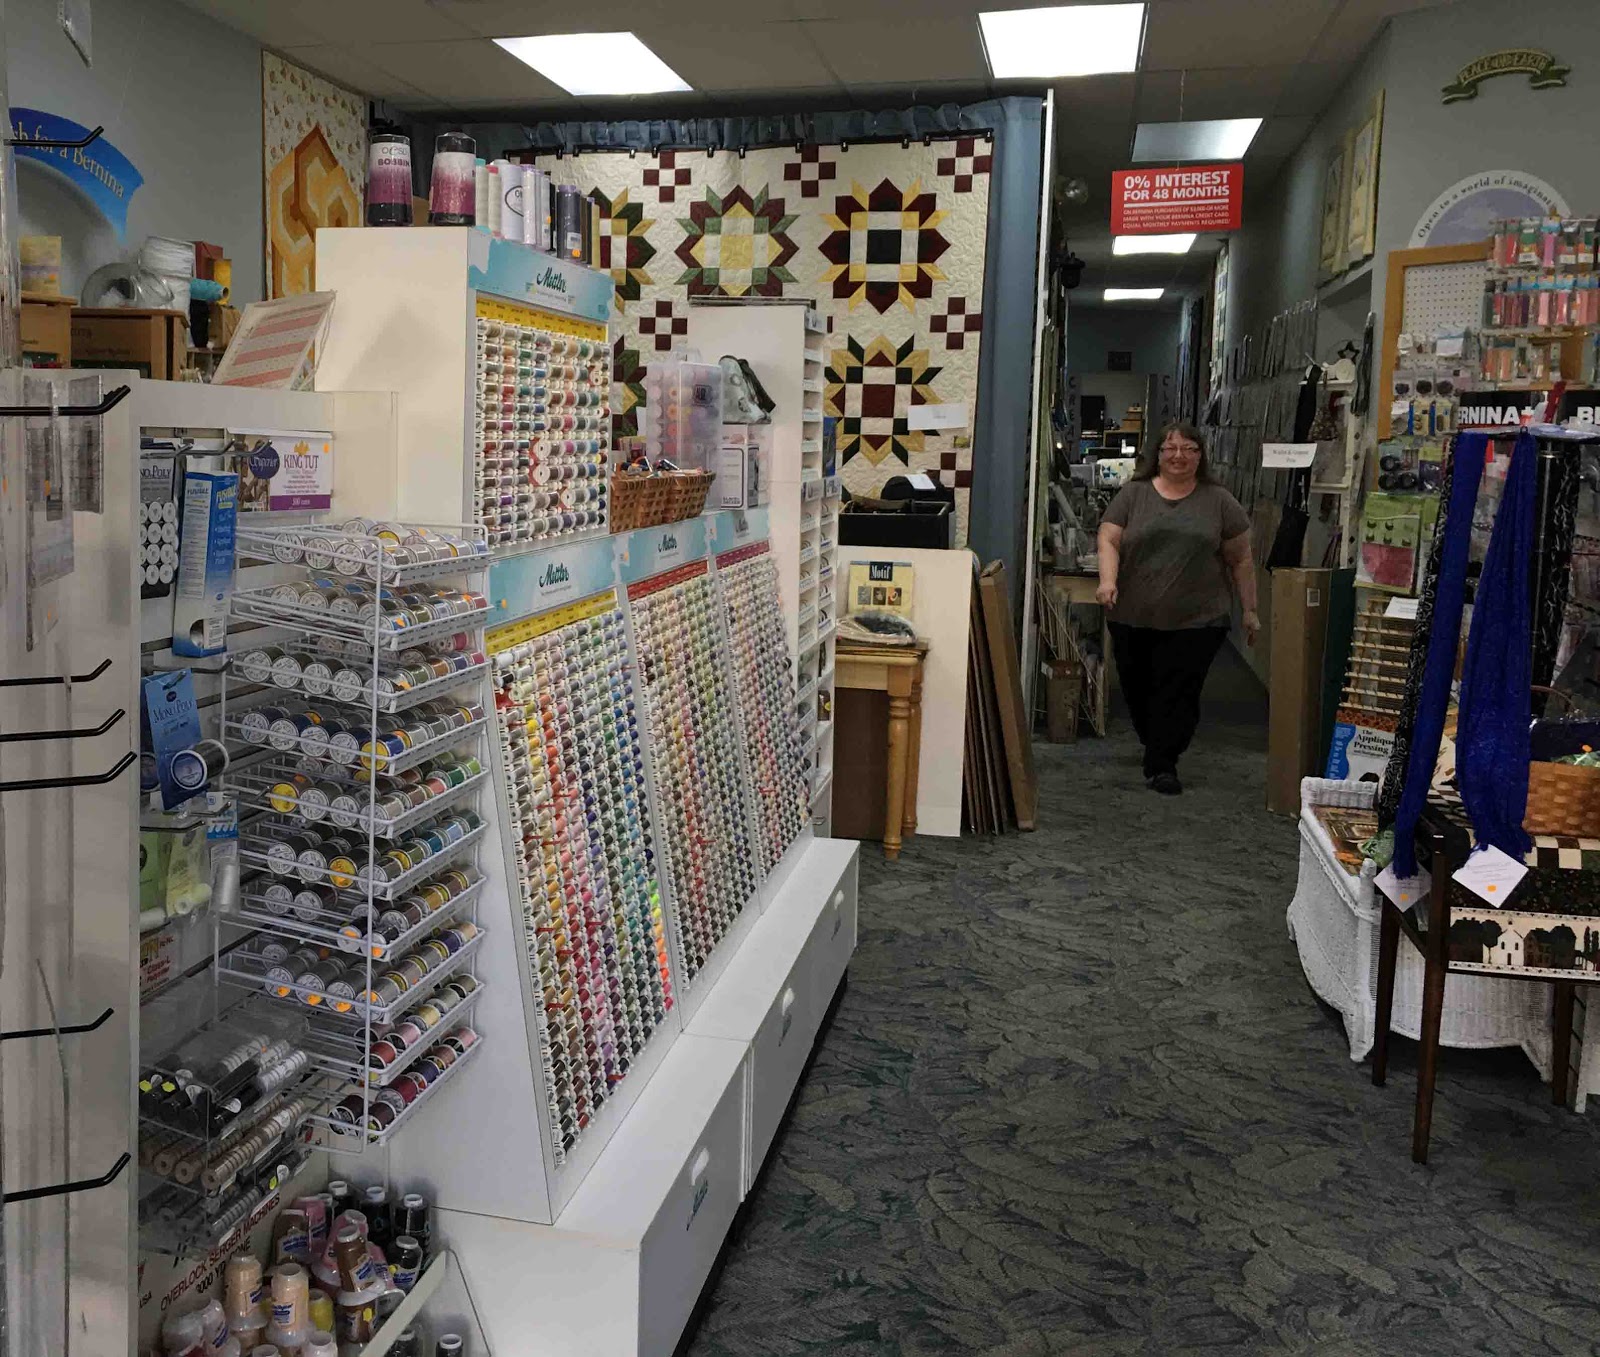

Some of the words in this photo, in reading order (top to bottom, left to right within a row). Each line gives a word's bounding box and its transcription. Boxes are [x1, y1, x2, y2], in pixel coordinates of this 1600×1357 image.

[73, 145, 125, 198] Bernina
[1124, 174, 1151, 189] 0%
[1155, 170, 1231, 188] INTEREST
[1123, 189, 1150, 201] FOR
[1152, 188, 1169, 200] 48
[1172, 185, 1230, 199] MONTHS
[1417, 211, 1439, 238] Open
[1440, 200, 1450, 209] to
[1460, 177, 1490, 194] world
[1494, 175, 1506, 185] of
[1508, 177, 1552, 206] imaginat
[284, 454, 303, 469] KING
[304, 455, 319, 469] TUT
[539, 562, 570, 588] Mettler
[871, 564, 891, 579] Motif
[1354, 741, 1389, 755] Pressing
[161, 1260, 207, 1311] OVERLOCK
[208, 1228, 241, 1266] SERGER
[243, 1193, 280, 1236] MACHINES
[230, 1236, 251, 1258] ONE
